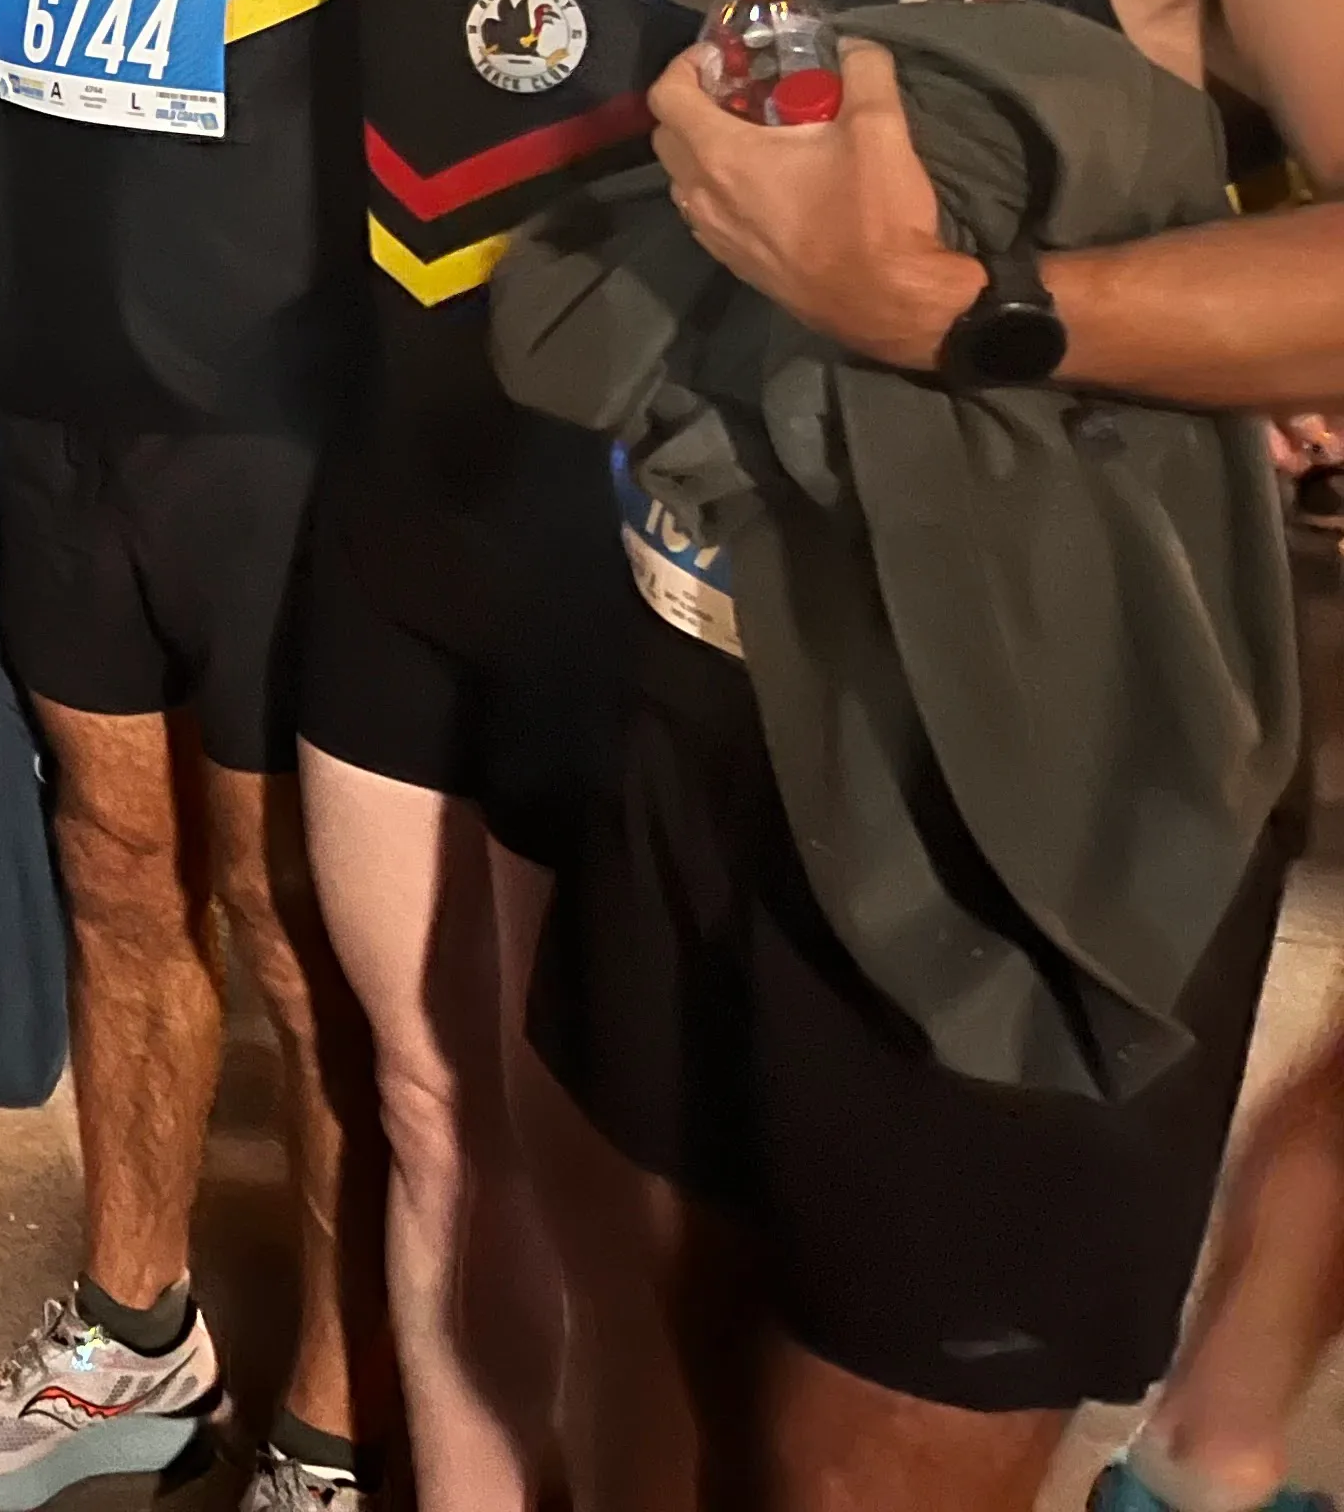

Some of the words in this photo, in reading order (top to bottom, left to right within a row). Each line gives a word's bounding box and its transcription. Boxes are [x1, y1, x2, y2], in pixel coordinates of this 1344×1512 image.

[476, 56, 521, 90] TRACK
[50, 81, 63, 100] A
[131, 92, 142, 111] L
